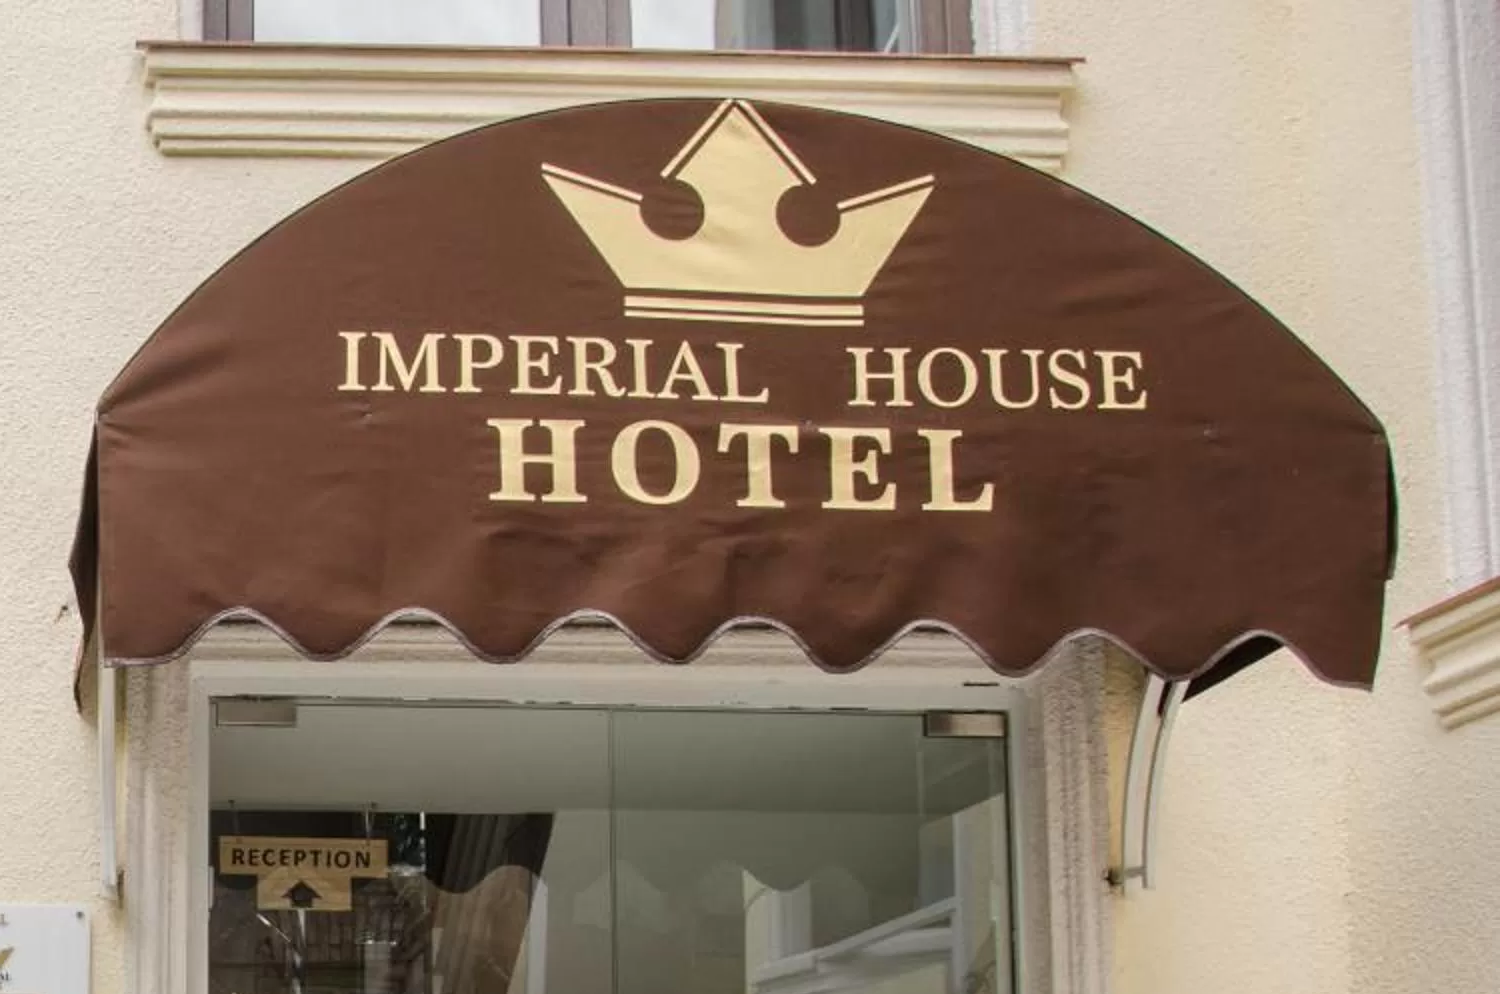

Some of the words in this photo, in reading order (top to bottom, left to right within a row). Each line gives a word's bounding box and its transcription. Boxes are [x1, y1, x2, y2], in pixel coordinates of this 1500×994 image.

[338, 331, 769, 403] IMPERIAL
[846, 347, 1148, 410] HOUSE
[487, 418, 995, 511] HOTEL
[231, 848, 372, 869] RECEPTION
